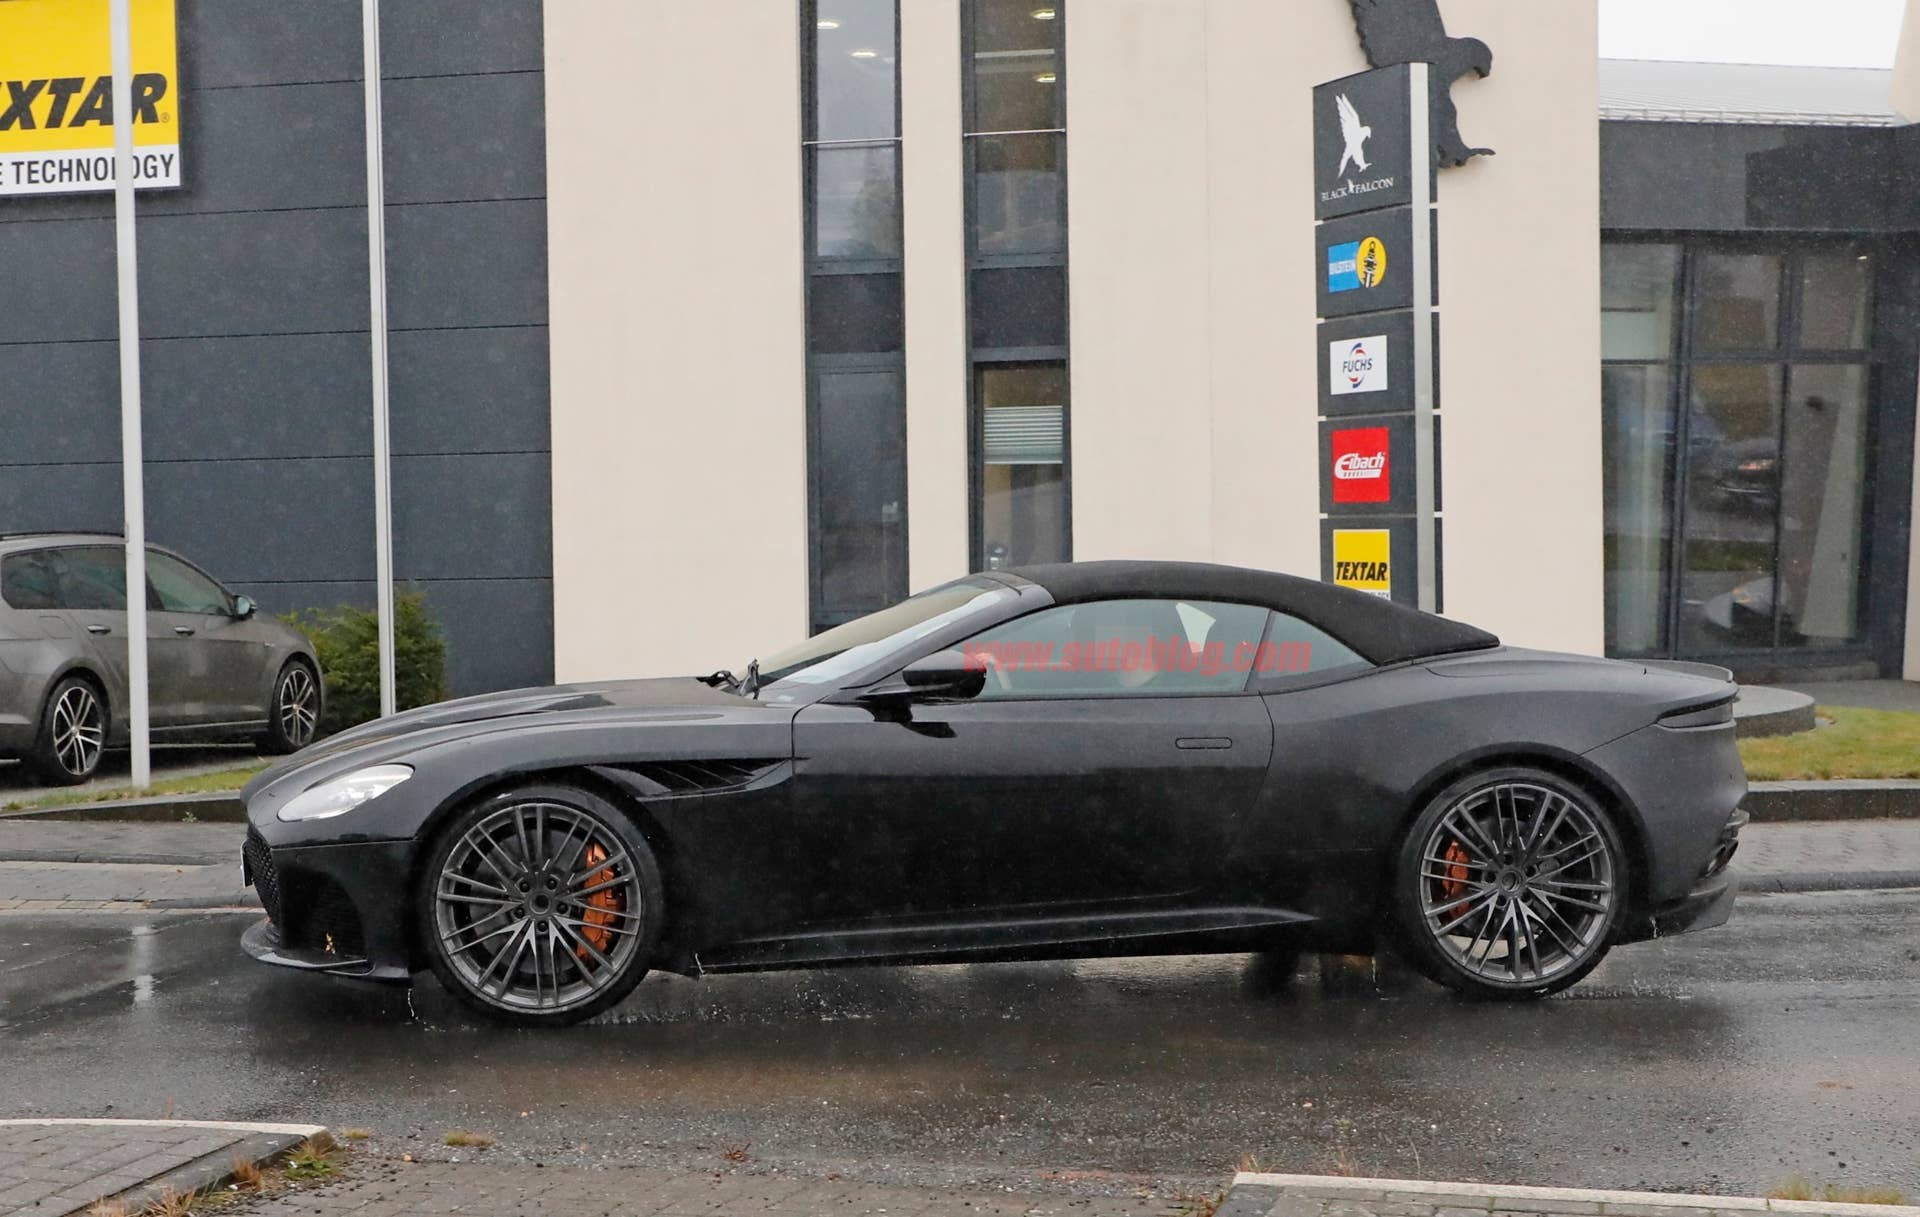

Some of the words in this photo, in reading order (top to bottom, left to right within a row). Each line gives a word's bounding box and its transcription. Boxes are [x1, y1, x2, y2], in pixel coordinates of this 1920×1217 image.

[0, 73, 167, 131] XTAR
[1321, 187, 1347, 201] BLACK
[1355, 177, 1394, 194] FALCON
[1342, 358, 1373, 373] FUCHS
[1335, 452, 1384, 479] Eibach
[1336, 561, 1387, 581] TEXTAR
